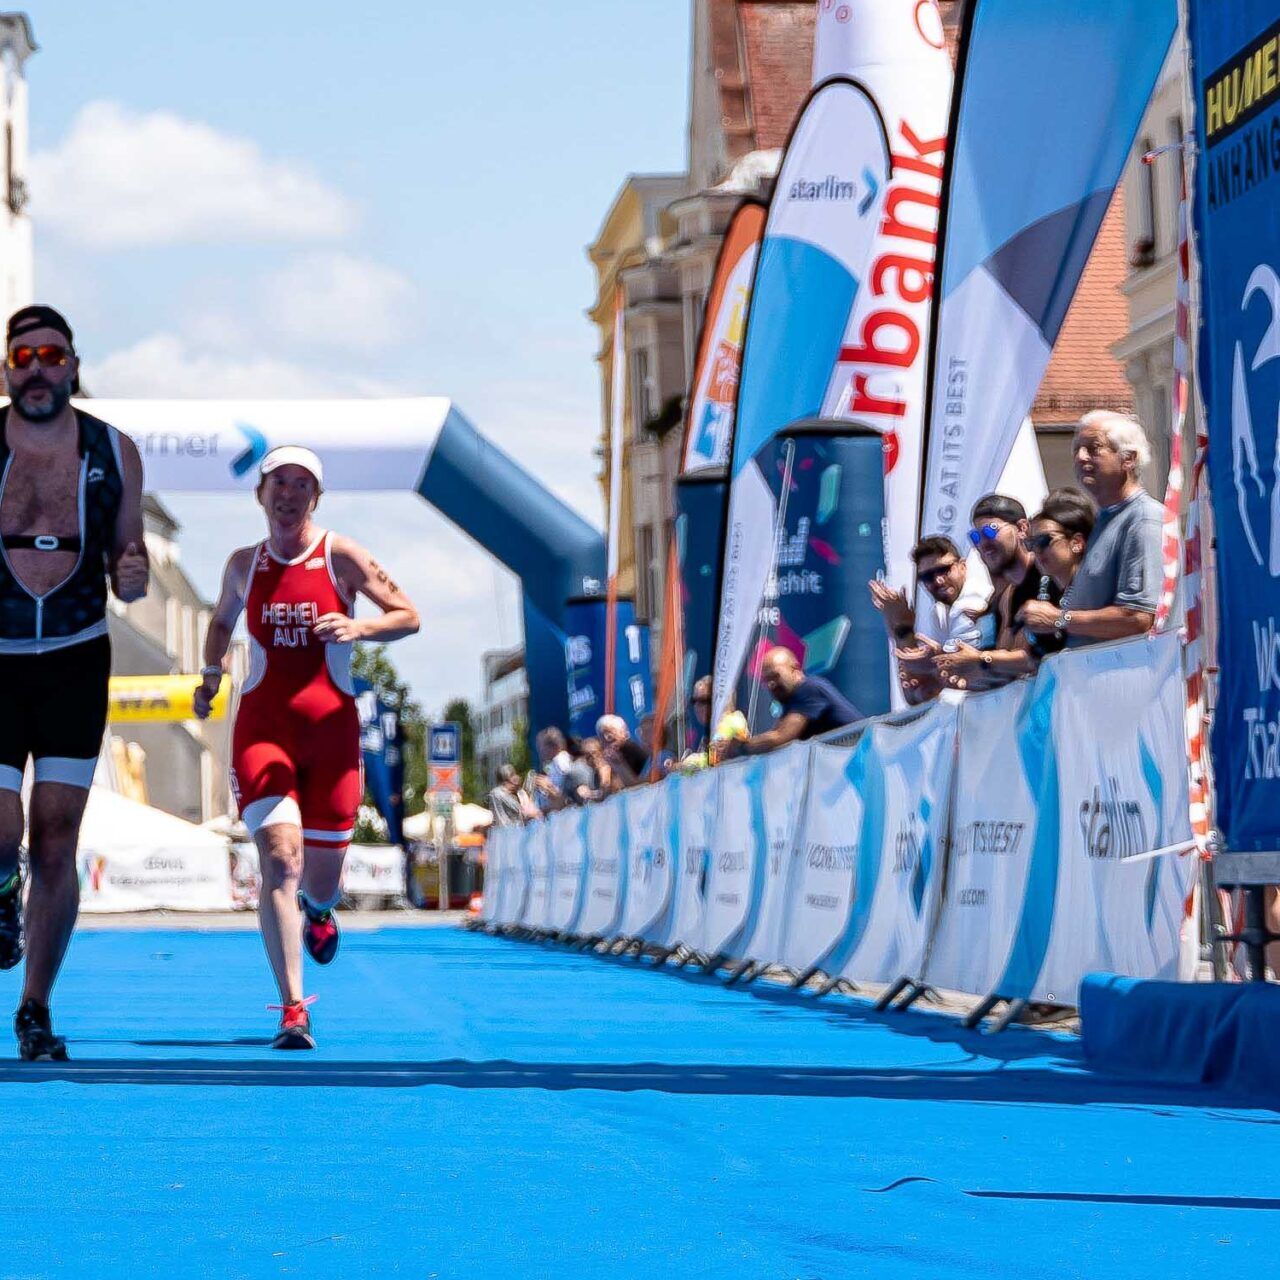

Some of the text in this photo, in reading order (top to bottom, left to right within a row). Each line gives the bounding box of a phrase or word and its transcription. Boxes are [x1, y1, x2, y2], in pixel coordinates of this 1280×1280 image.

[1207, 34, 1280, 138] HUME
[788, 175, 856, 202] starlim
[943, 356, 968, 417] BEST
[942, 424, 963, 462] ITS
[939, 467, 961, 500] AT
[273, 627, 310, 647] AUT
